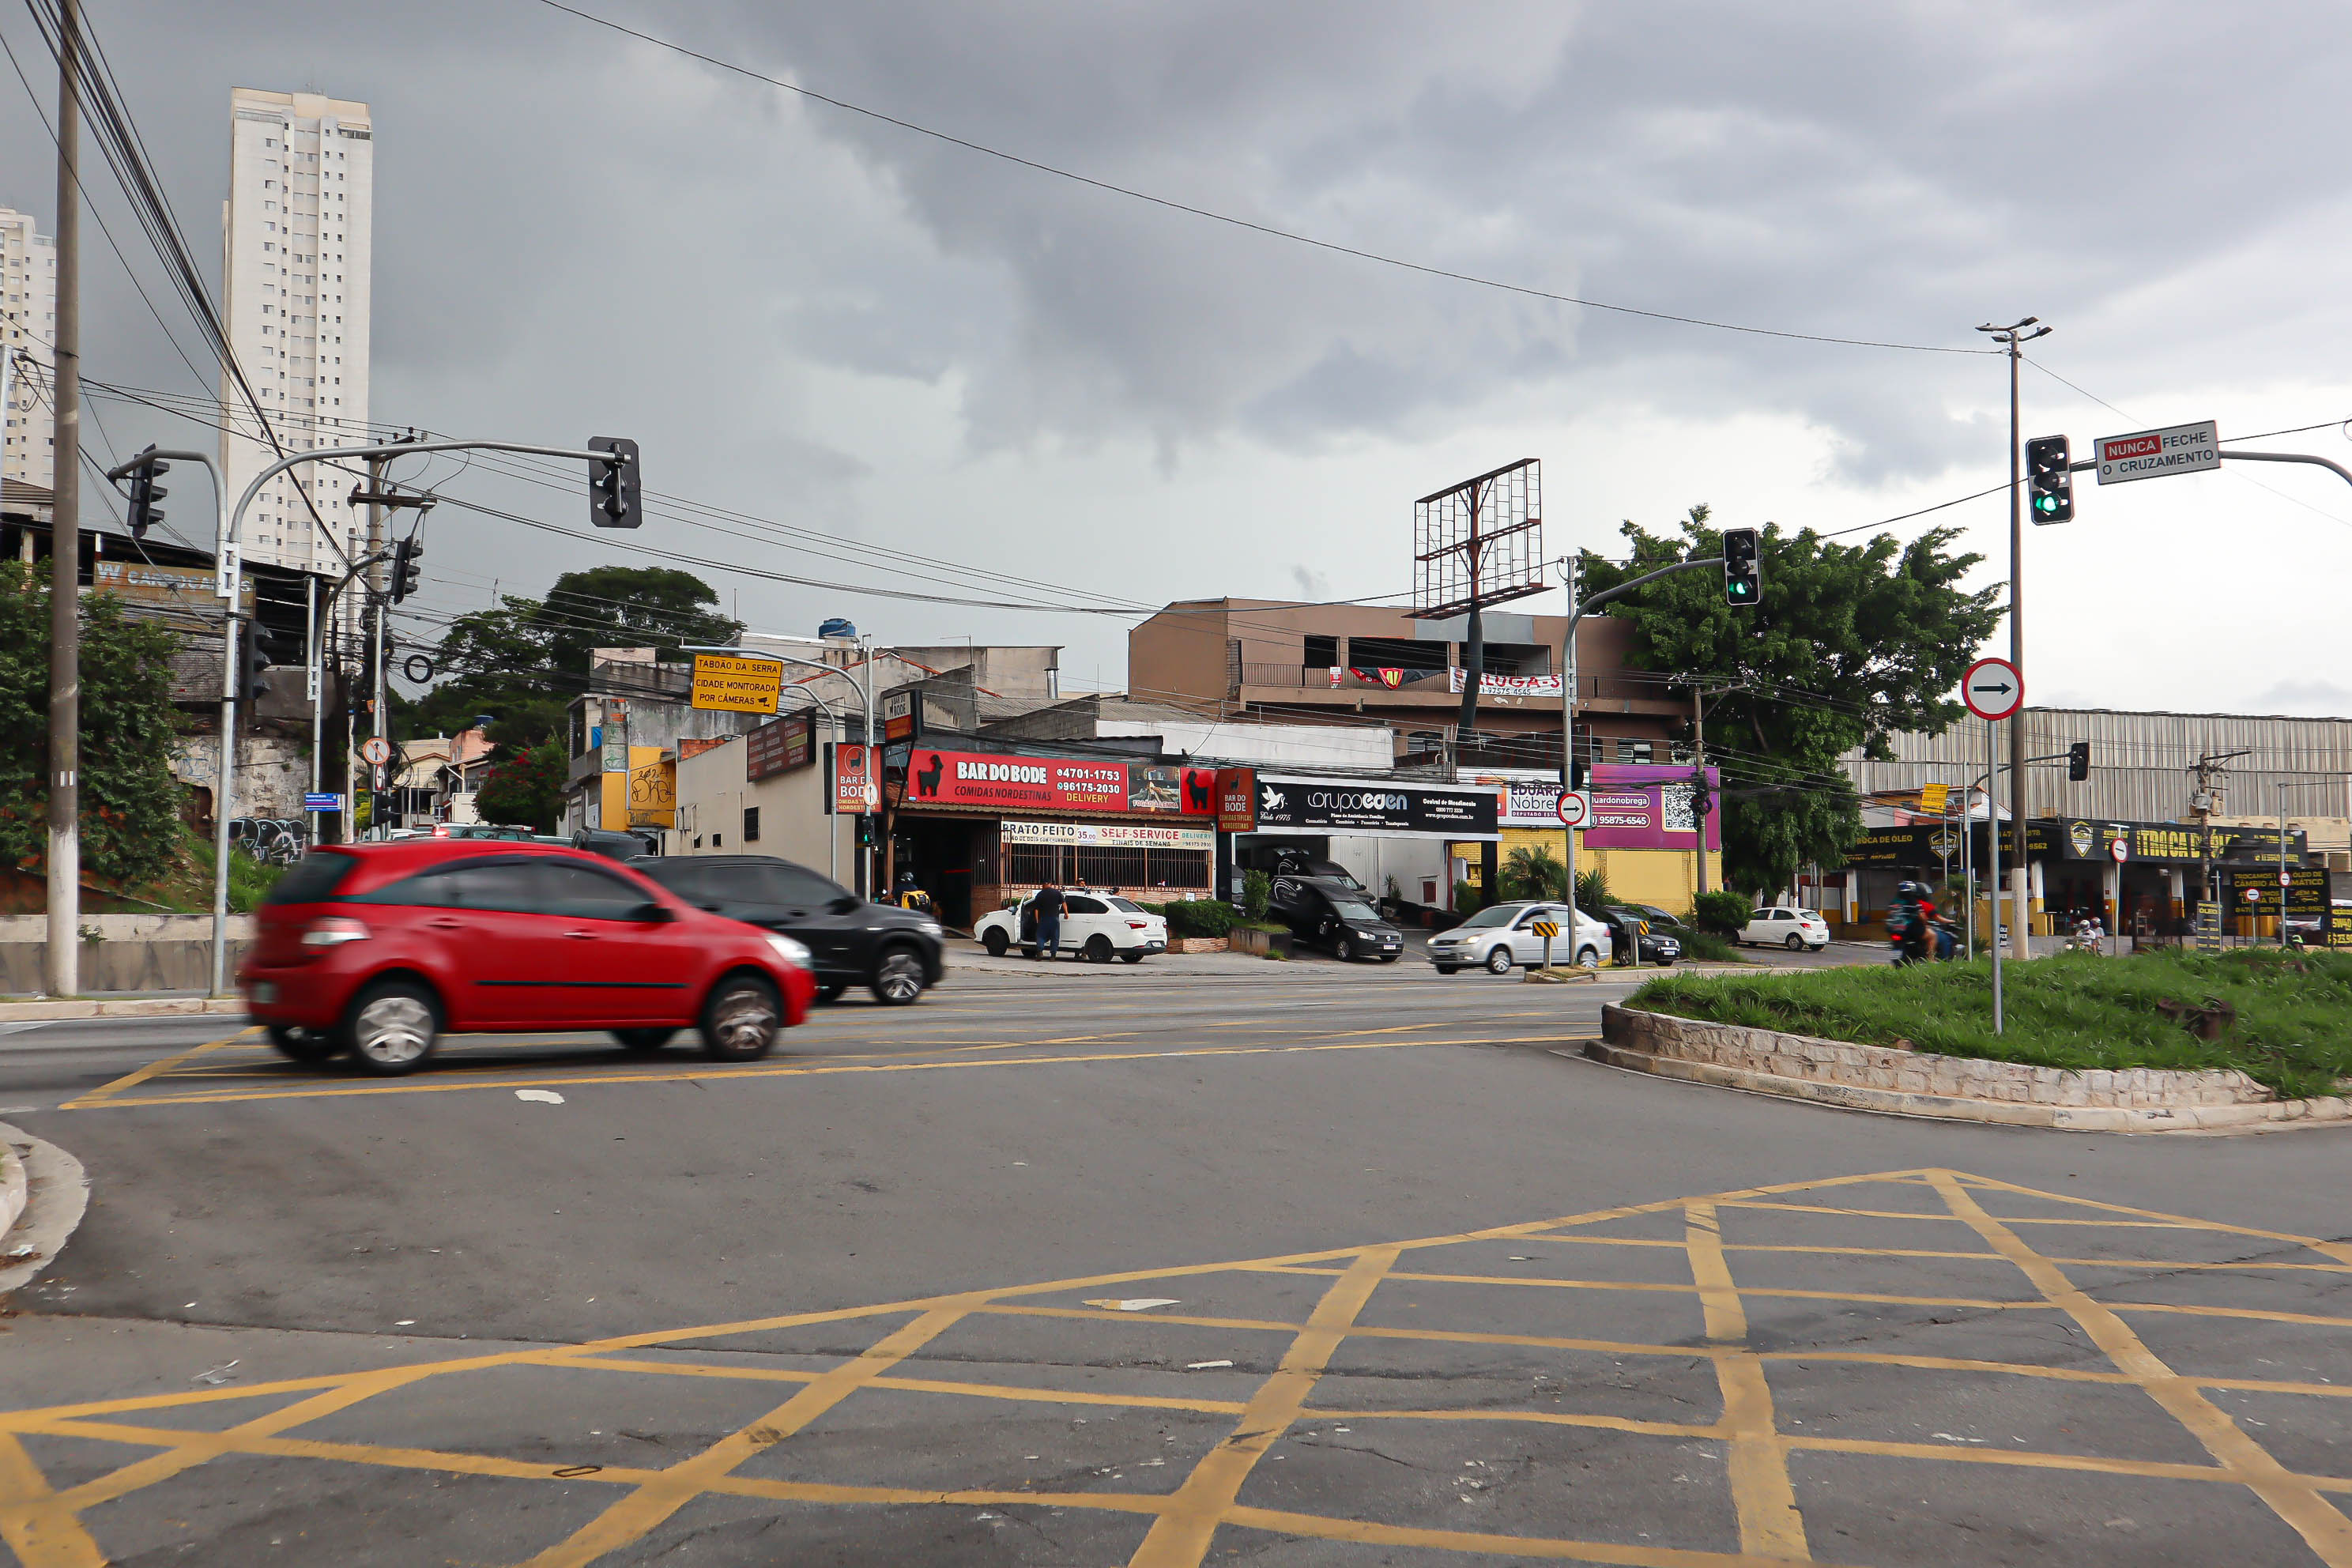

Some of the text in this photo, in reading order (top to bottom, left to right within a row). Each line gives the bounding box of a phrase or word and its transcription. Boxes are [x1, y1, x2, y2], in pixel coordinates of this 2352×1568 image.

[2109, 431, 2208, 457] NUNCA FECHE
[2102, 449, 2214, 475] O CRUZAMENTO
[699, 659, 732, 669] TABOÃO
[752, 664, 778, 673] SERRA
[695, 679, 776, 692] CIDADE MONITORADA
[718, 693, 755, 705] CÂMERAS
[956, 761, 1047, 784] BAR DO BODE
[1063, 768, 1120, 782] 4701-1753
[840, 775, 858, 784] BAR
[840, 786, 865, 797] BOD
[955, 786, 1052, 801] COMIDAS NORDESTINAS
[1063, 782, 1120, 794] 96175-2030
[1511, 784, 1564, 797] EDUARD
[1066, 793, 1109, 804] DELIVERY
[1511, 796, 1555, 809] Nóbre
[1225, 802, 1246, 812] BODE
[1275, 812, 1291, 822] 1975
[1600, 816, 1647, 825] 95875-6545
[1002, 824, 1075, 836] PRATO FEITO
[1101, 827, 1179, 840] SELF-SERVICE
